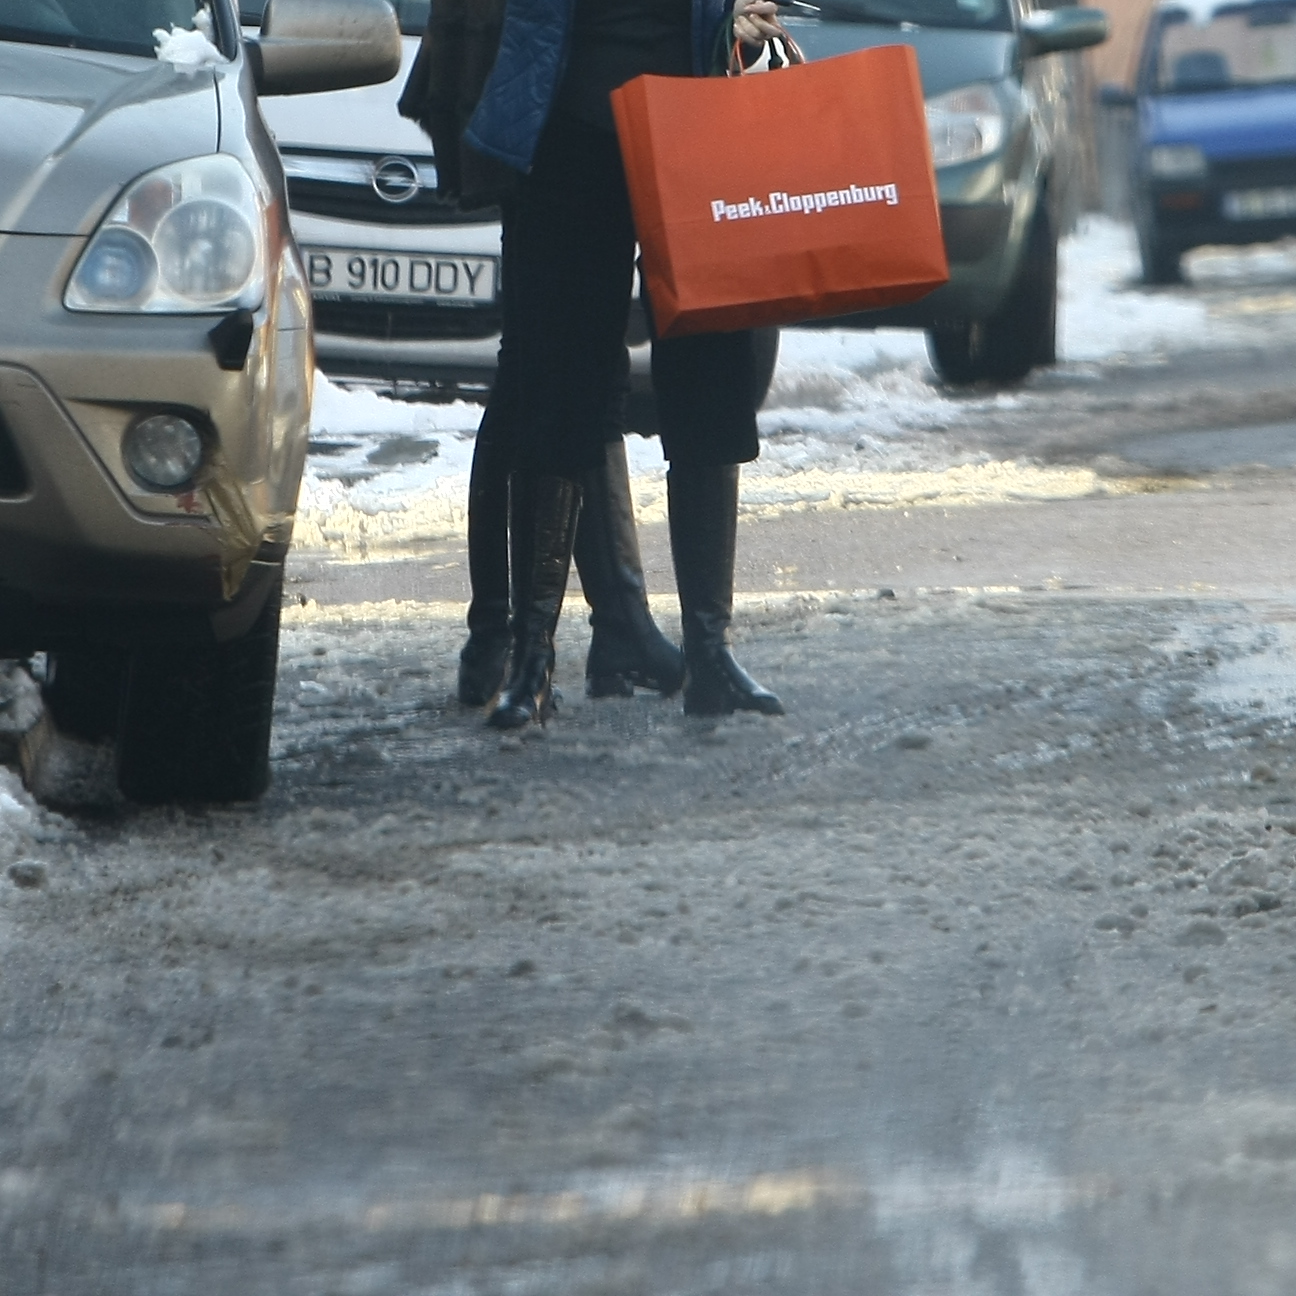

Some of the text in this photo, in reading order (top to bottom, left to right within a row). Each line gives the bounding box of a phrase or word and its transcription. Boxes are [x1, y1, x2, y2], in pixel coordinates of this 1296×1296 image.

[308, 254, 485, 296] B 910 DDY
